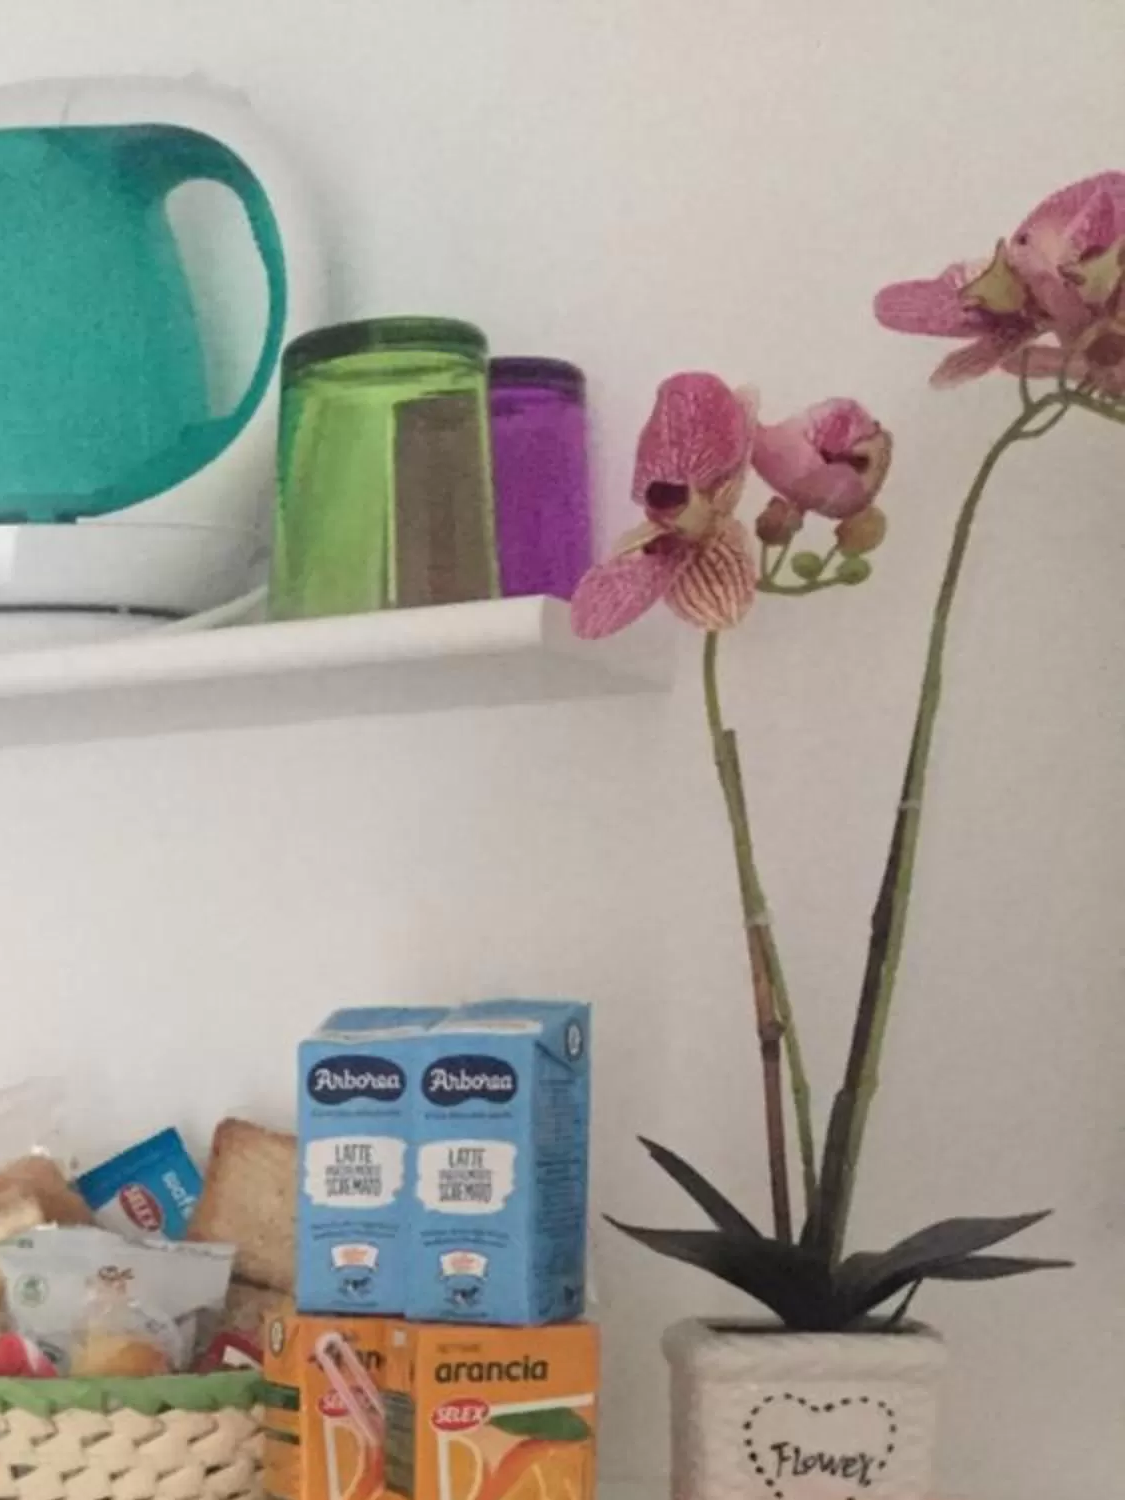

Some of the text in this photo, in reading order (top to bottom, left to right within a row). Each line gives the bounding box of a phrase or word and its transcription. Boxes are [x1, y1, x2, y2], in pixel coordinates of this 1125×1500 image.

[314, 1068, 402, 1092] Arborea
[429, 1068, 514, 1093] Arborea
[335, 1143, 373, 1164] LATTE
[448, 1148, 486, 1168] LATTE
[435, 1354, 549, 1384] arancia
[436, 1402, 488, 1424] SELEX
[769, 1441, 876, 1488] Flower
